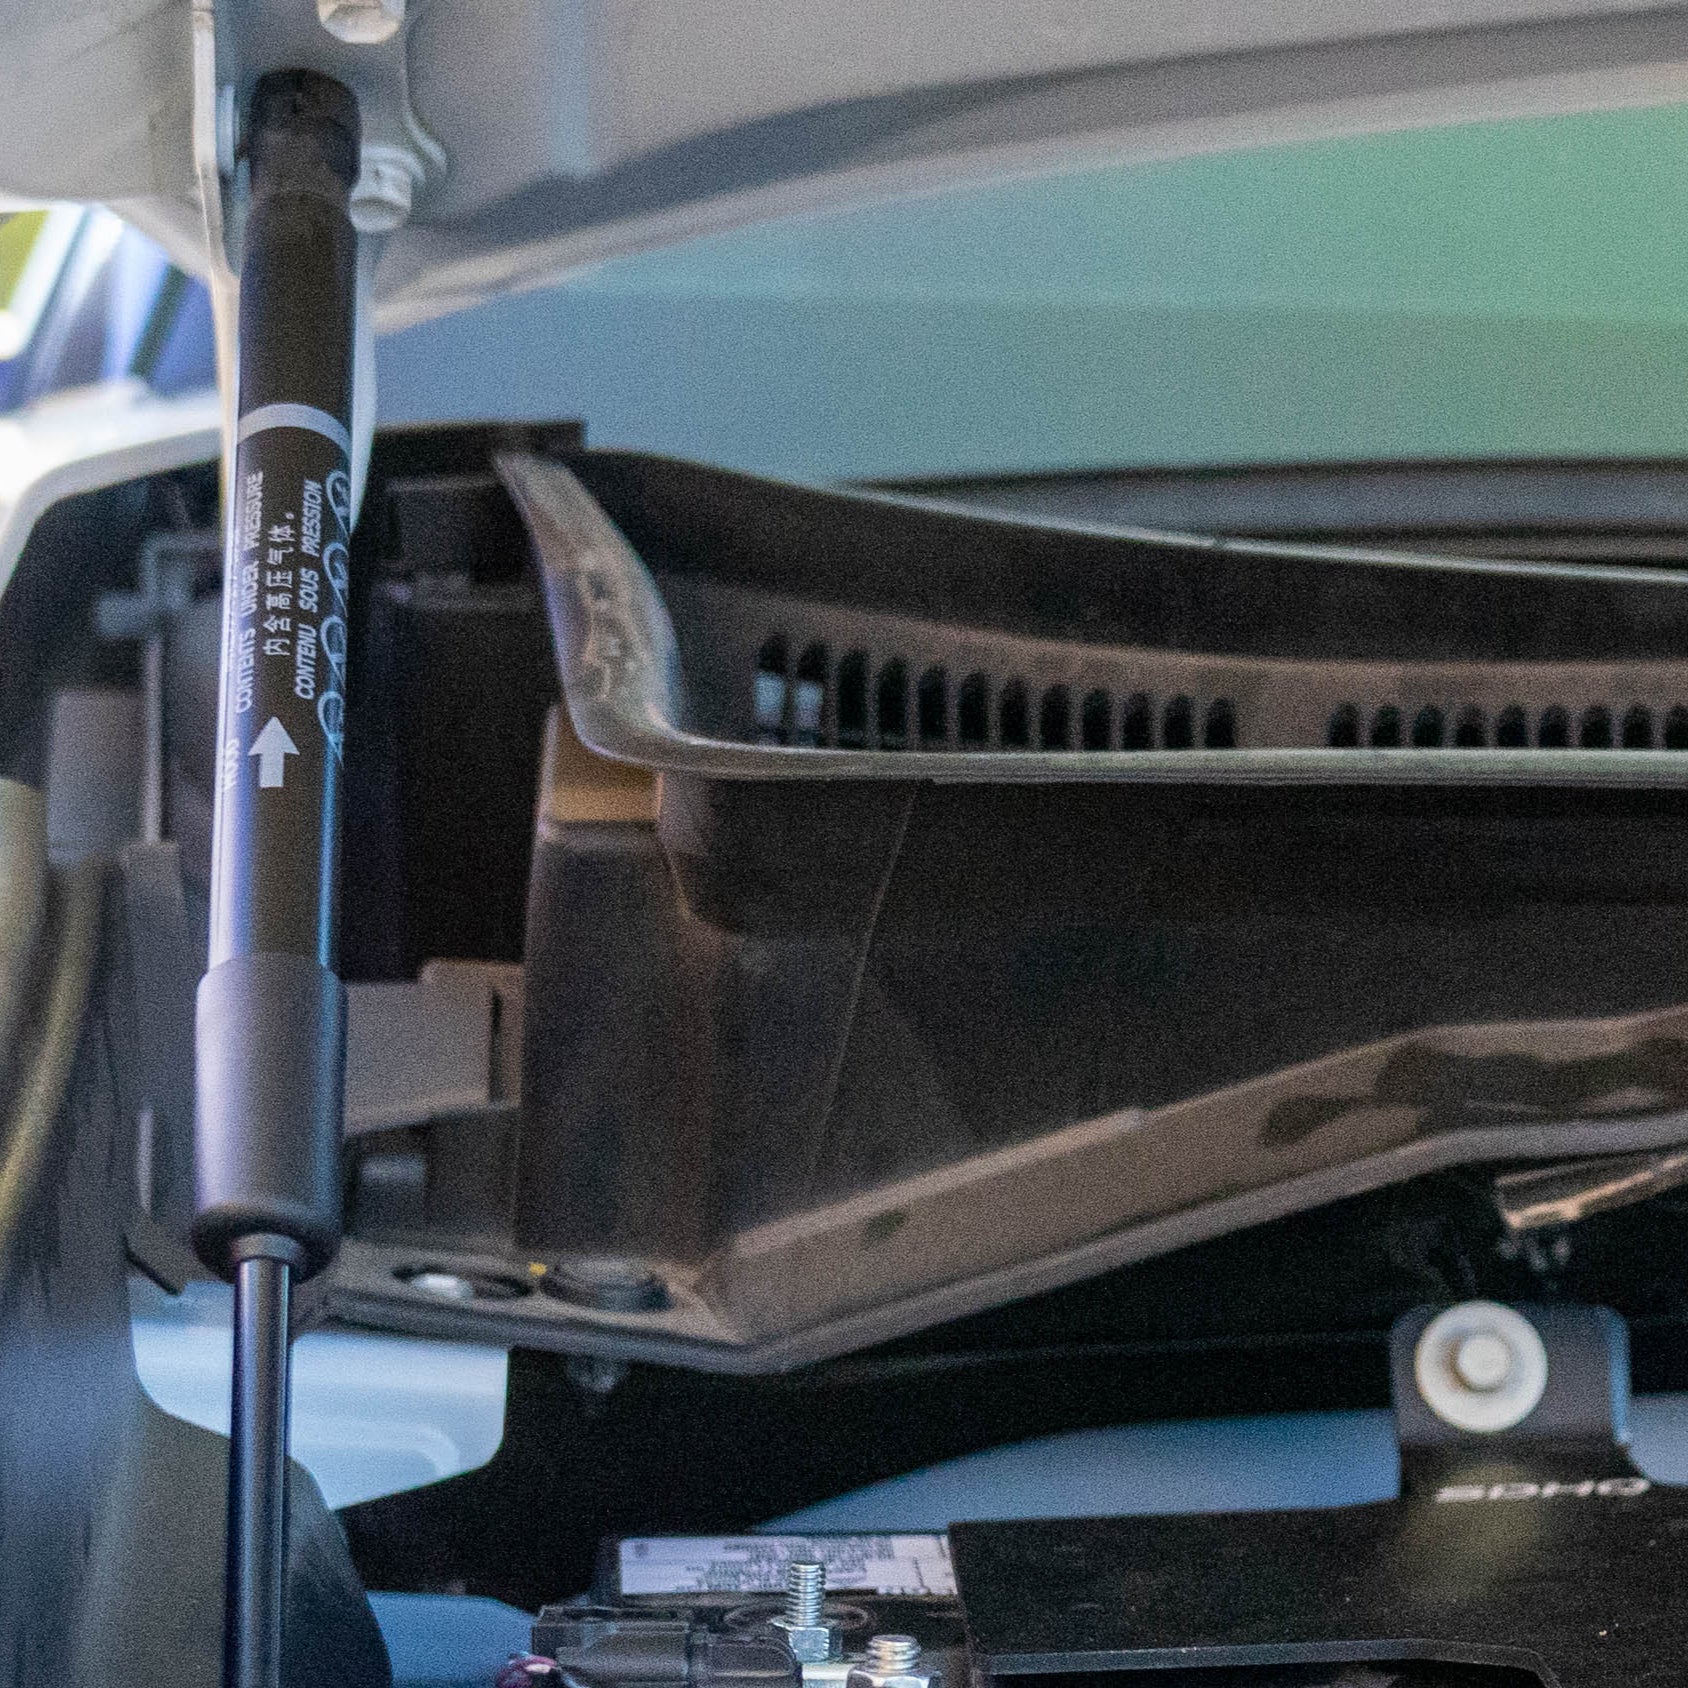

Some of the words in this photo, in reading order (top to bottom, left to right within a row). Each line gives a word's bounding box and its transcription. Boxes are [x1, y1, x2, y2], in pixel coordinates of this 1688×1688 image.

[242, 470, 263, 552] PRESSURE
[301, 478, 323, 558] PRESSION
[239, 559, 260, 618] UNDER
[262, 512, 296, 656] 内含高压气体。
[299, 566, 320, 613] SOUS
[236, 627, 257, 714] CONTENTS
[294, 622, 318, 700] CONTENU
